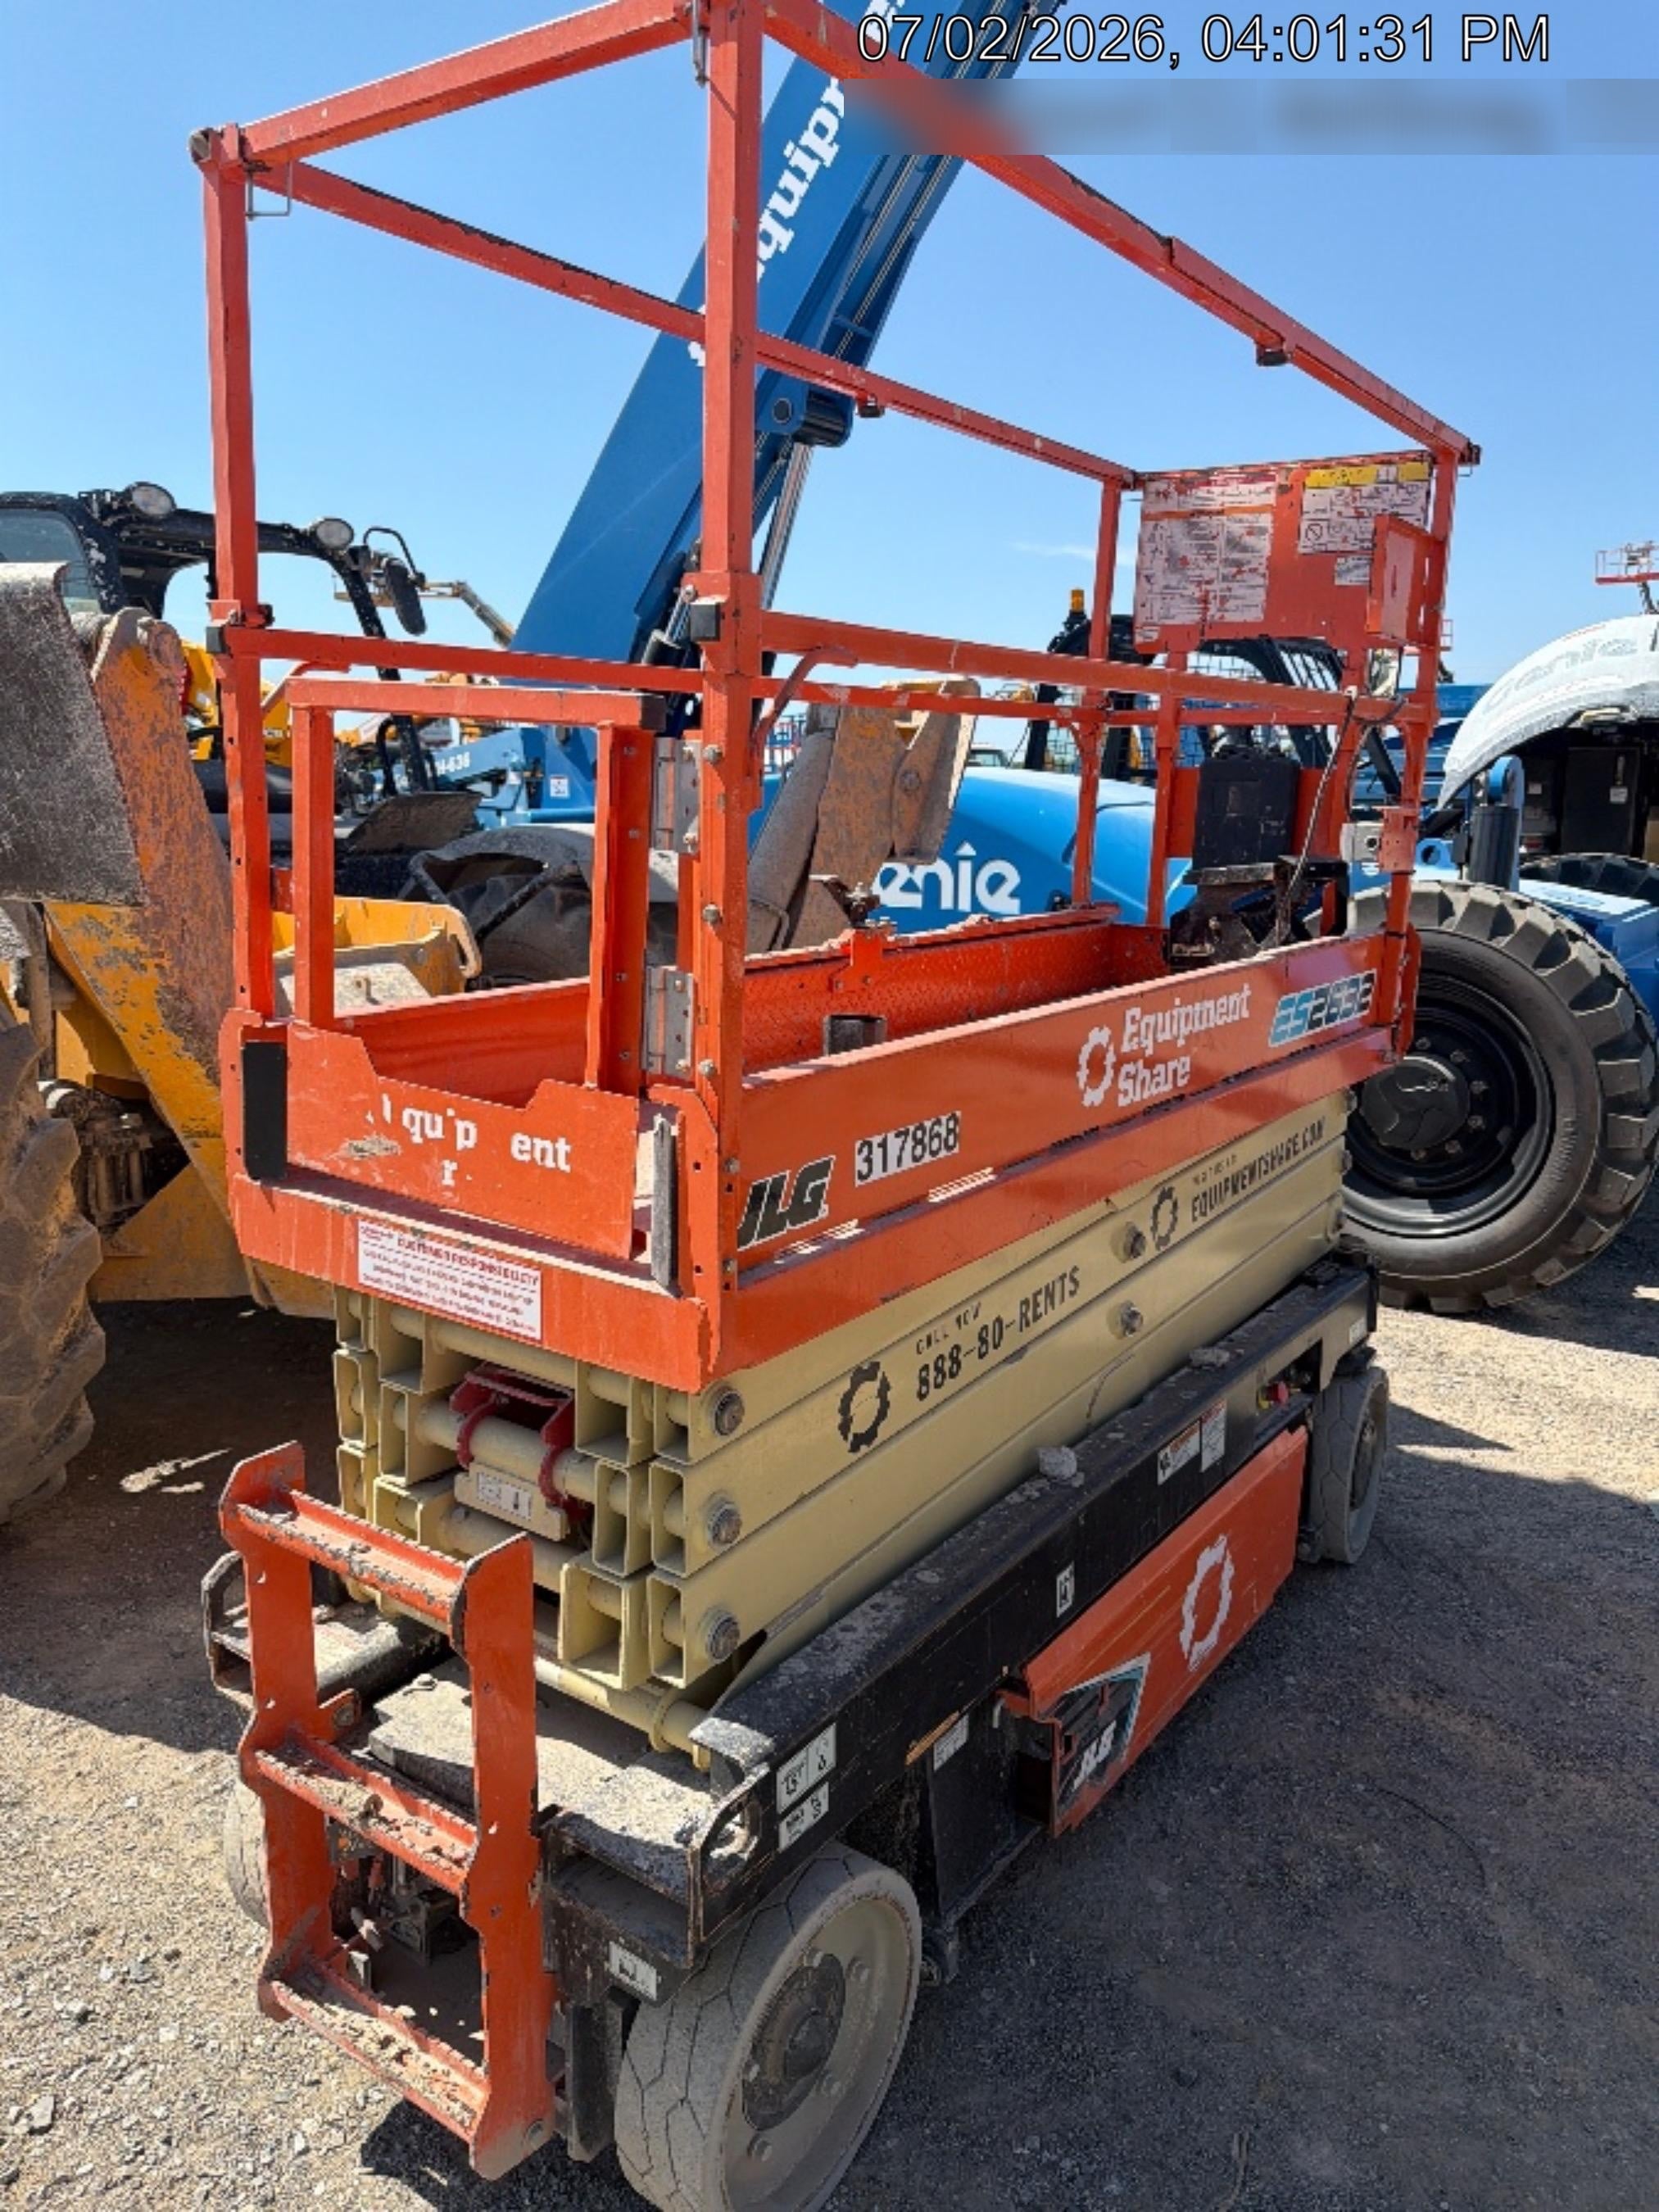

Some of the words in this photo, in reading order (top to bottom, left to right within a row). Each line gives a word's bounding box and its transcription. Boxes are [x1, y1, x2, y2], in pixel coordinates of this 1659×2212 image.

[871, 841, 1021, 915] enie
[1121, 983, 1251, 1057] Equipment
[1117, 1054, 1190, 1107] Share
[858, 1111, 959, 1182] 317868
[737, 1155, 836, 1252] JLG
[916, 1265, 1081, 1402] 888-80-RENTS
